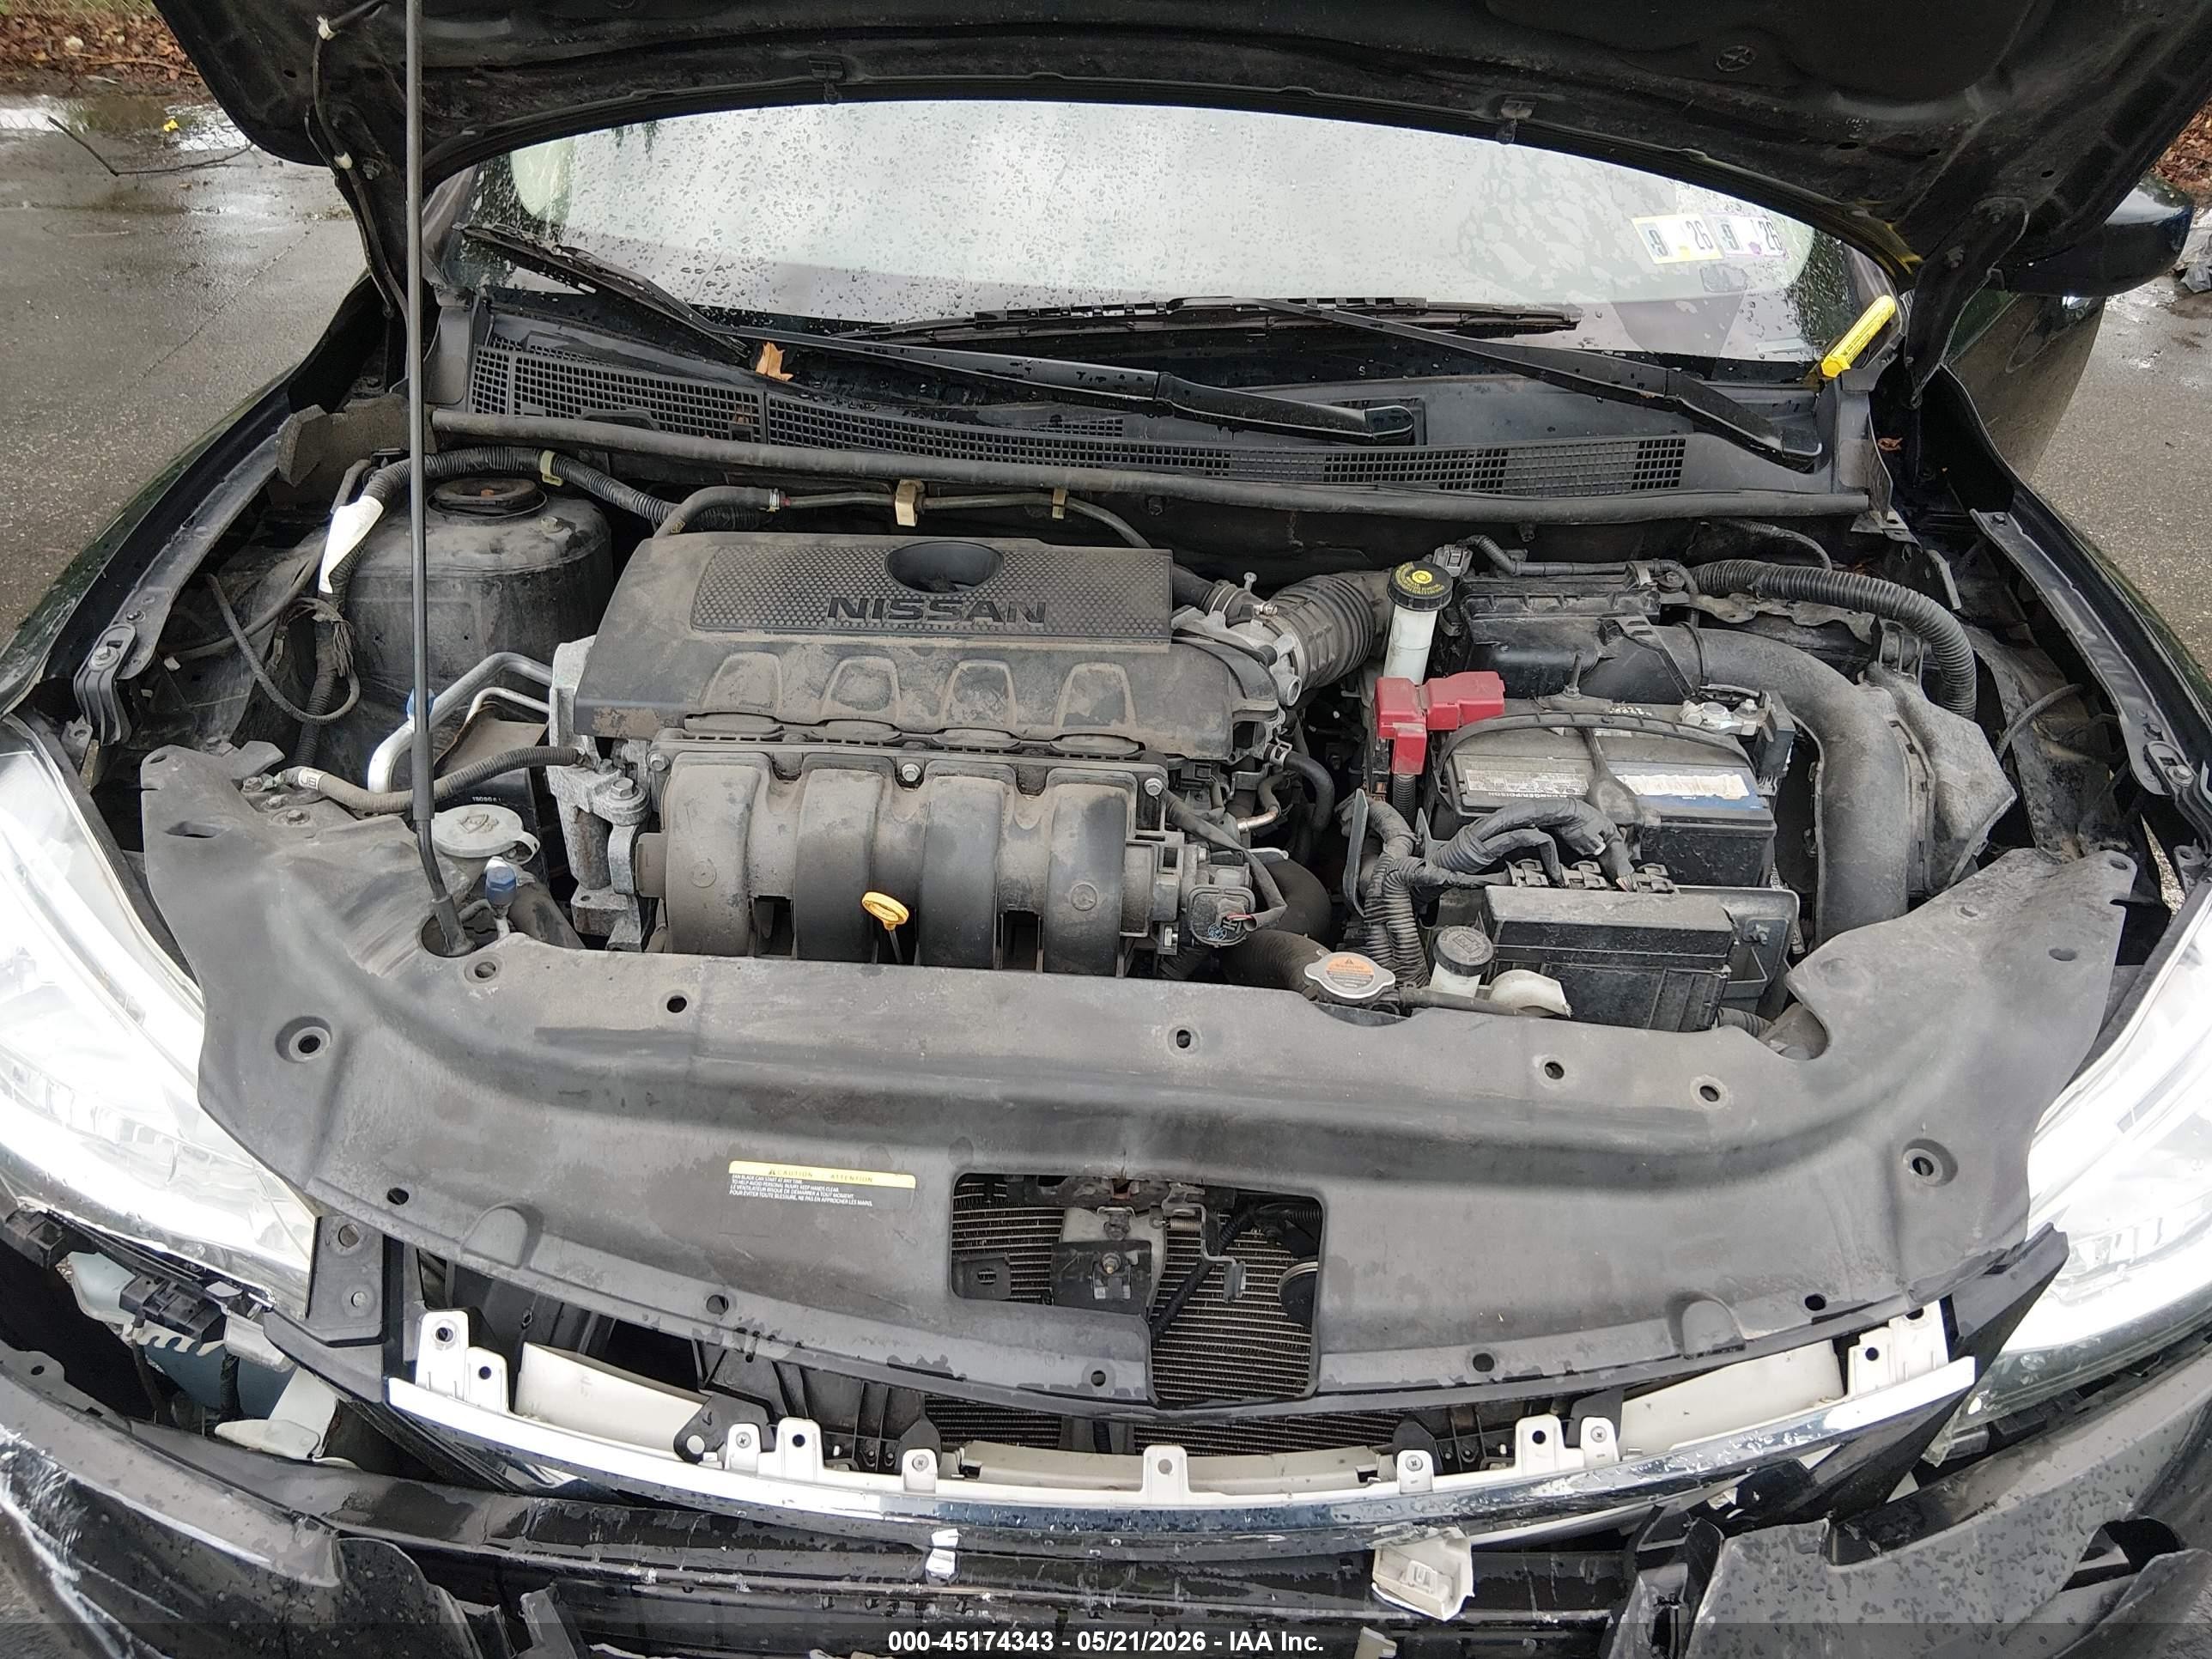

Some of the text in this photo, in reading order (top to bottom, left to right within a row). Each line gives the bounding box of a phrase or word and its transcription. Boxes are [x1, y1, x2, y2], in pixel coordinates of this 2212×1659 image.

[1648, 220, 1713, 258] 9 26
[1721, 220, 1784, 252] 9 26
[826, 597, 1047, 625] NISSAN
[830, 1174, 872, 1182] ATTENTION
